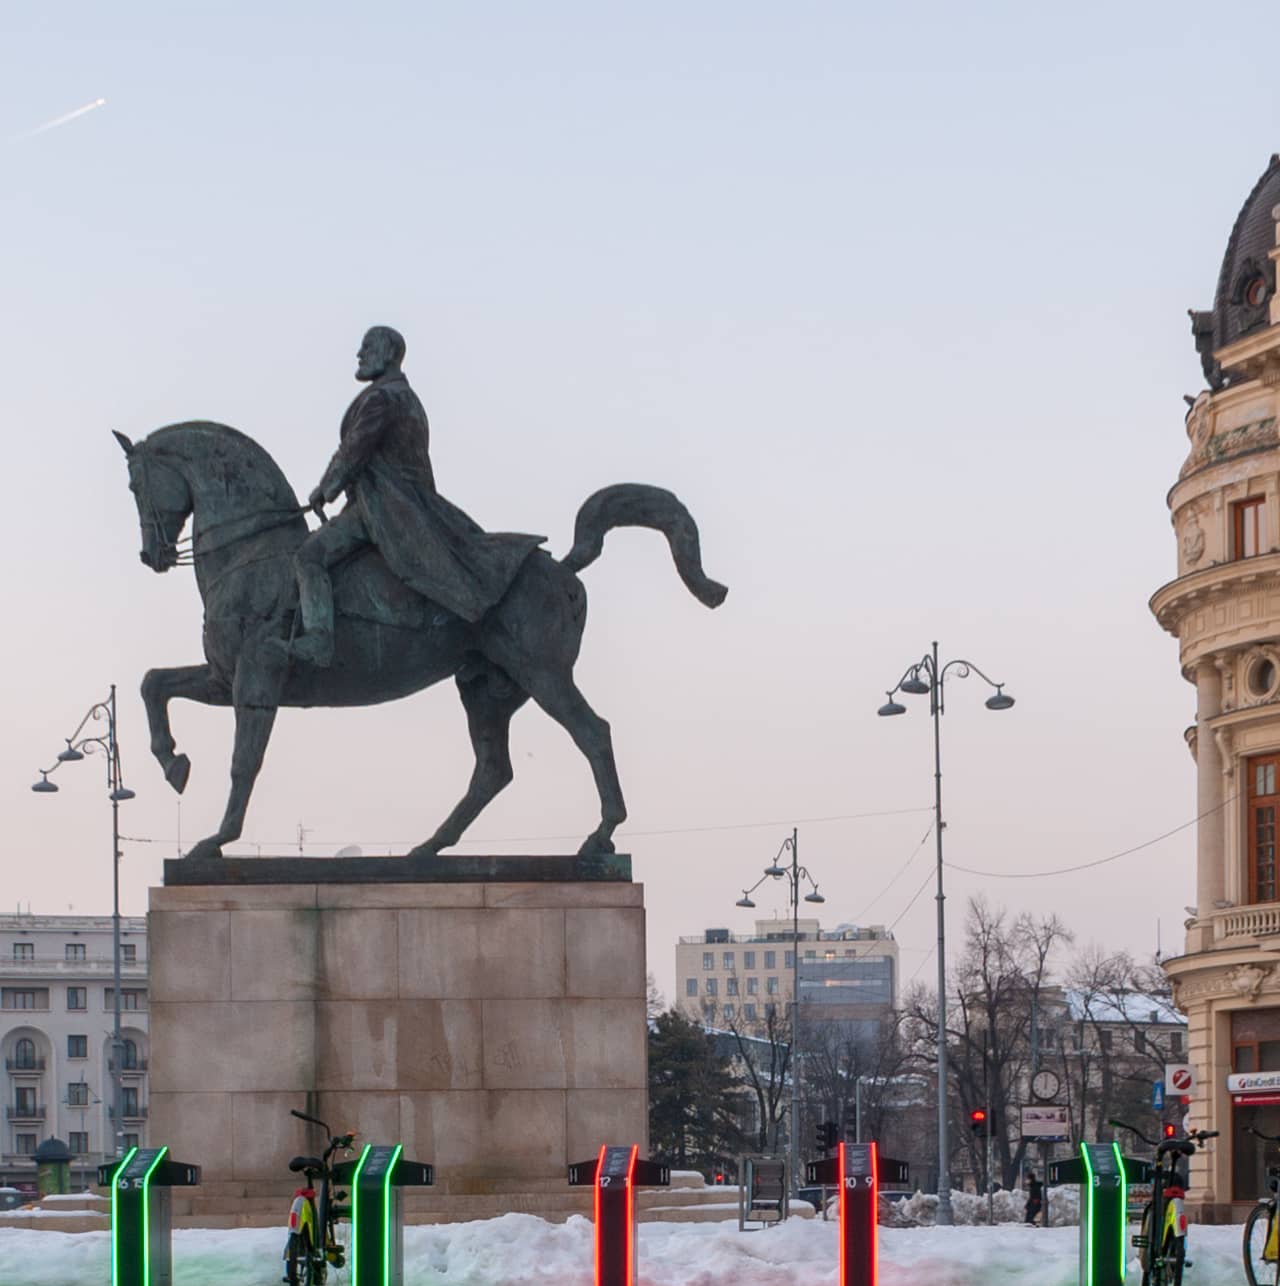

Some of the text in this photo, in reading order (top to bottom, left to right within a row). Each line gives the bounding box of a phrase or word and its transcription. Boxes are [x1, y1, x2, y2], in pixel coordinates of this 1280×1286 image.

[845, 1176, 874, 1189] 10 9
[1114, 1175, 1122, 1187] 7
